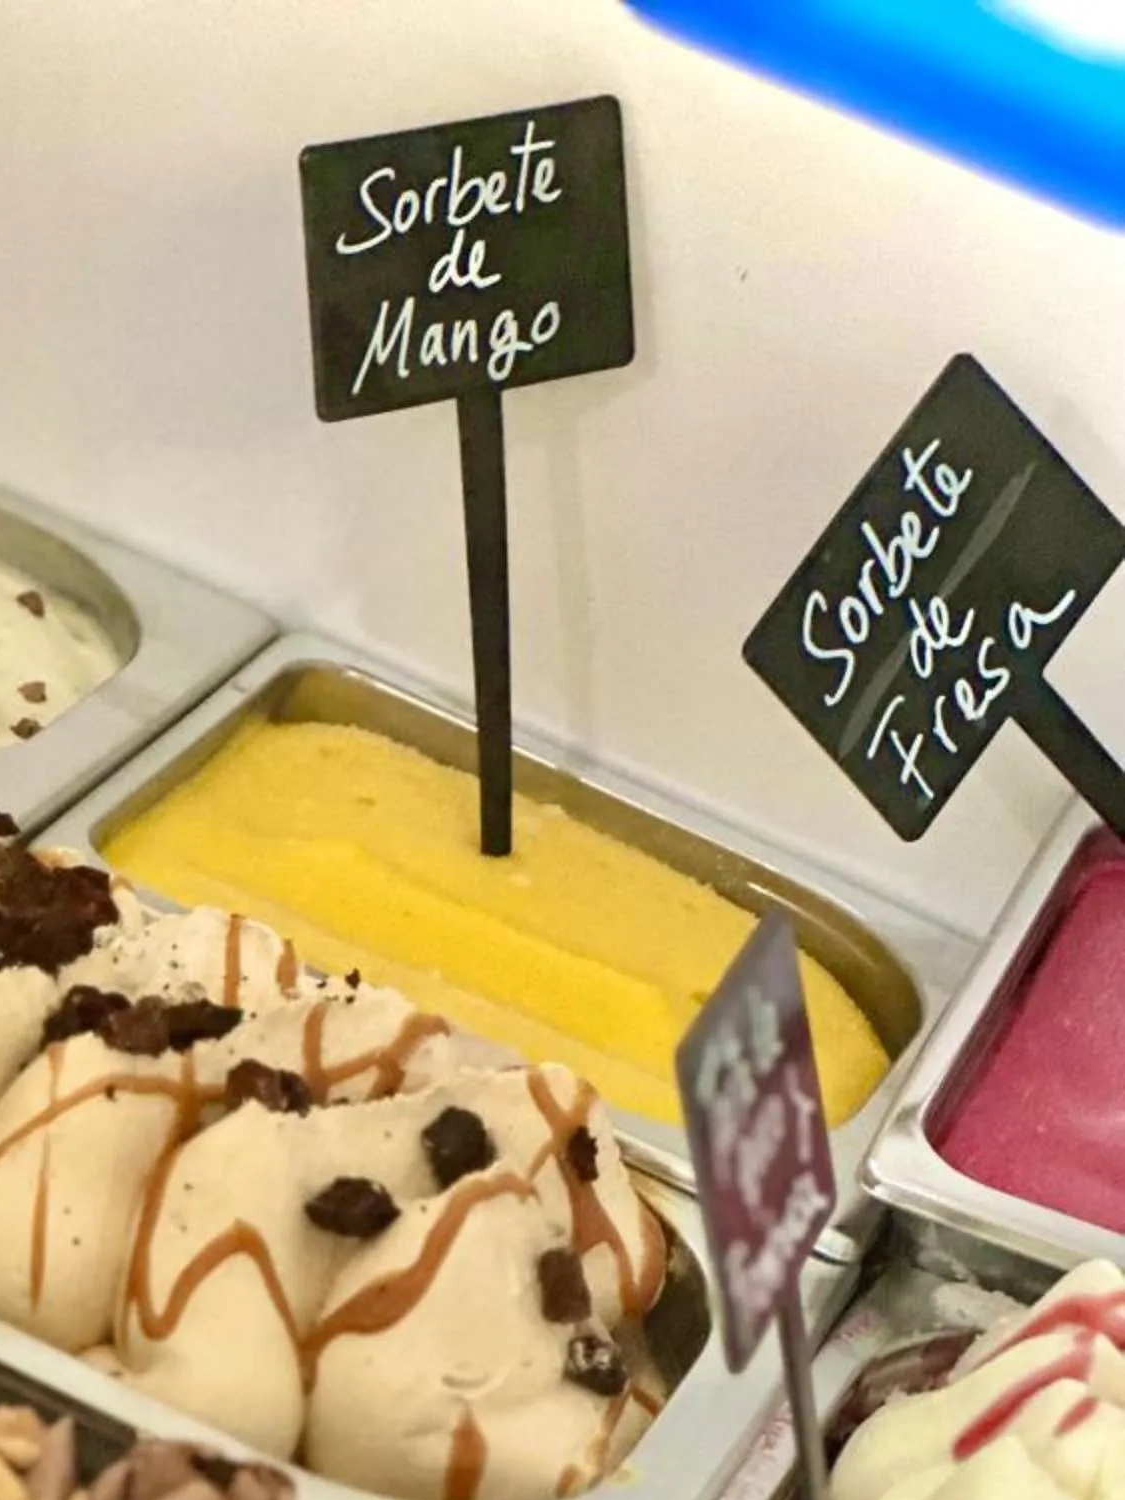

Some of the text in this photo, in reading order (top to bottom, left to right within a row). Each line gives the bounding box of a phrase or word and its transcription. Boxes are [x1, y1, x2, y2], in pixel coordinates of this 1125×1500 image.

[336, 120, 562, 254] Sorbete
[428, 229, 501, 292] de
[351, 297, 561, 395] Mango
[802, 438, 973, 706] Sorbete
[867, 589, 1076, 799] Fresa
[909, 597, 975, 679] de
